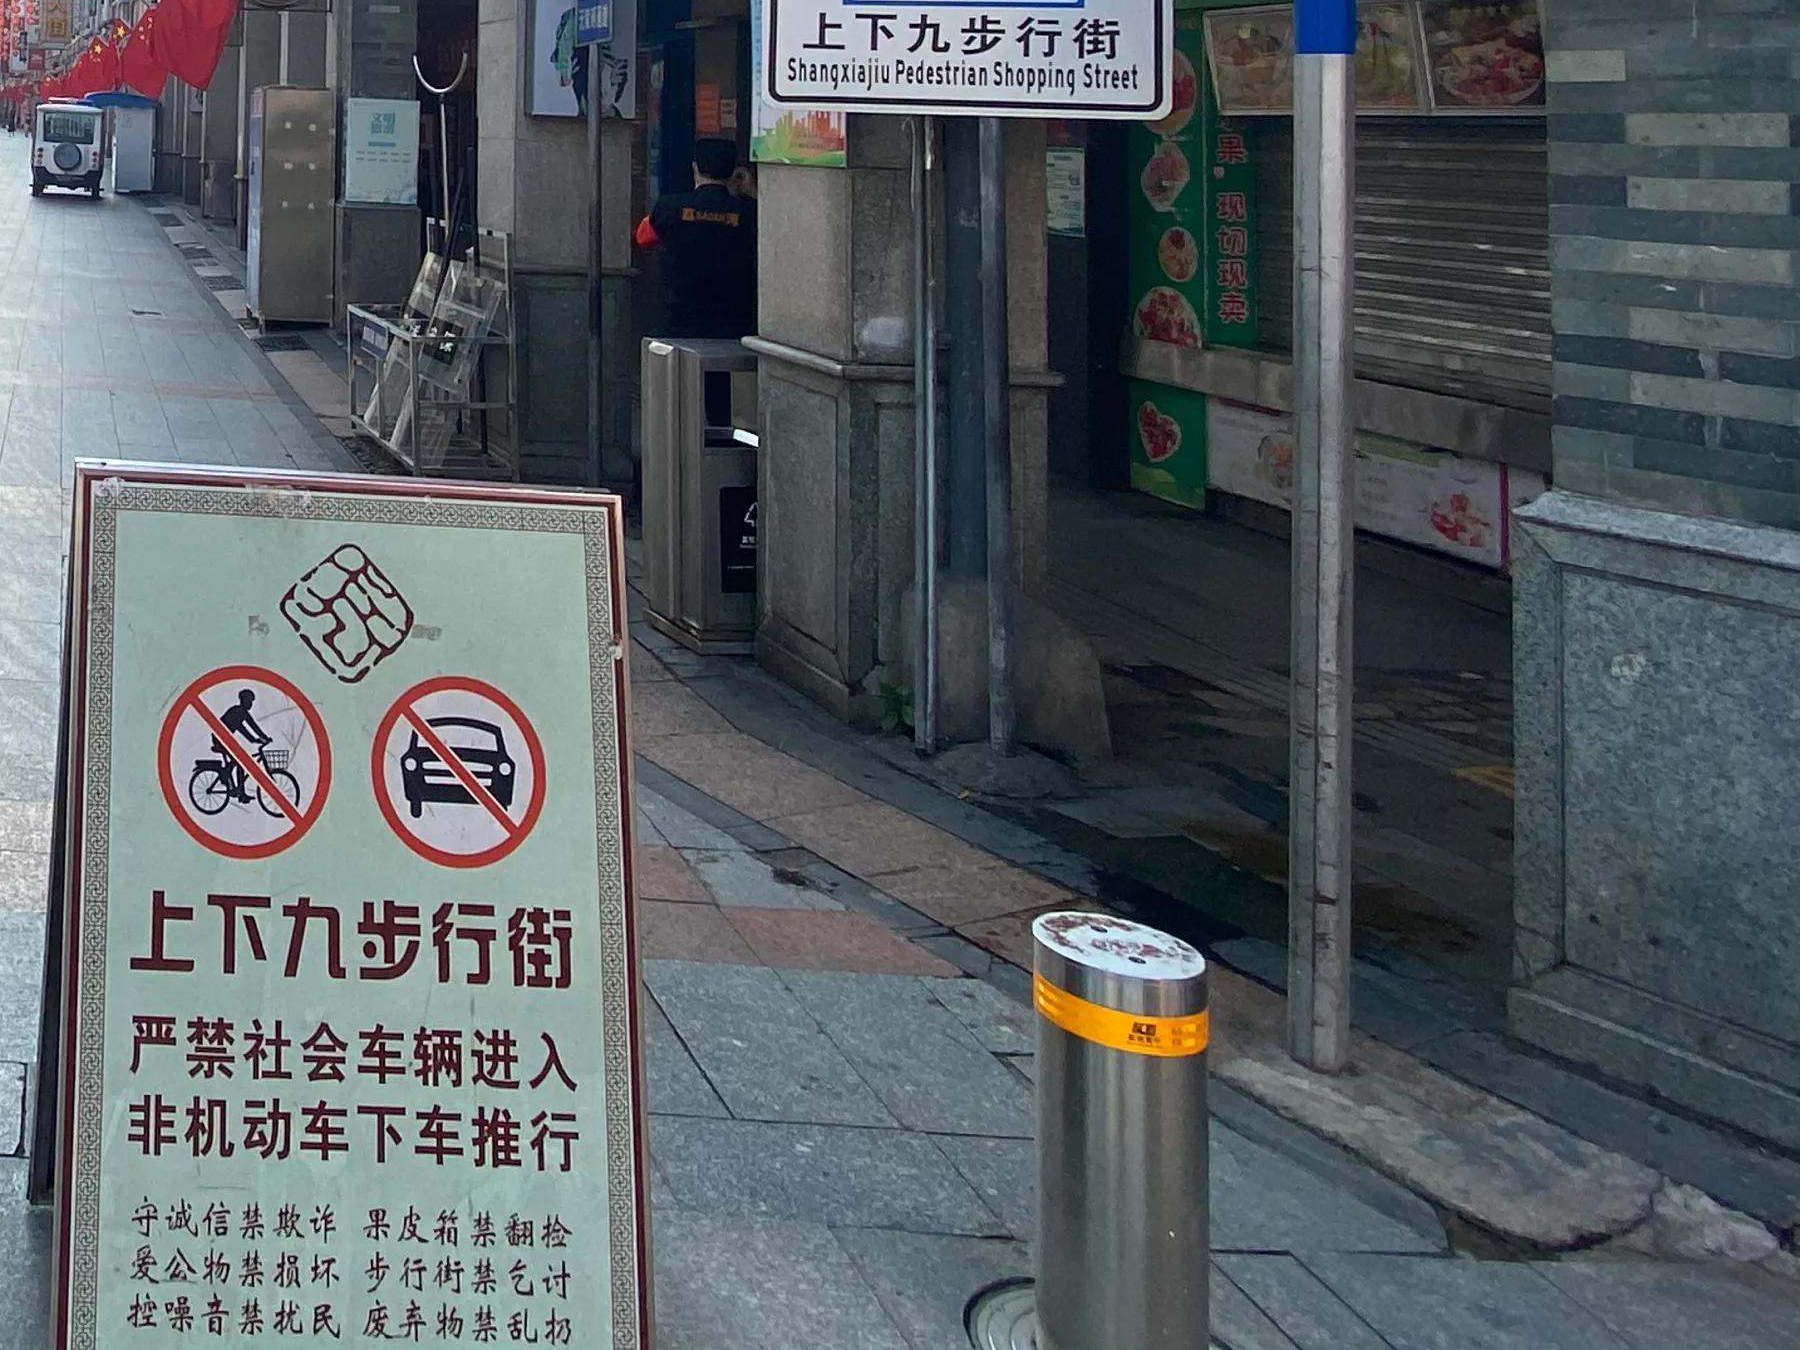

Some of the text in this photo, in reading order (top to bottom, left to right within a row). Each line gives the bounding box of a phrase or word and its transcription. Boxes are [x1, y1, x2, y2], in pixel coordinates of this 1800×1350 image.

[802, 11, 1122, 60] 上下九步行街
[786, 57, 1139, 96] Shangxiajiu Pedestrian Shopping Street
[129, 890, 574, 989] 上下九步行街
[128, 1014, 580, 1092] 严禁社会车辆进入
[127, 1094, 581, 1174] 非机动车下车推行
[131, 1196, 574, 1249] 守诚信禁欺诈 果皮箱禁翻捡
[130, 1247, 573, 1301] 爱公物禁损坏 步行街禁乞讨
[126, 1293, 574, 1347] 控噪音禁扰民 废弃物禁乱扔
